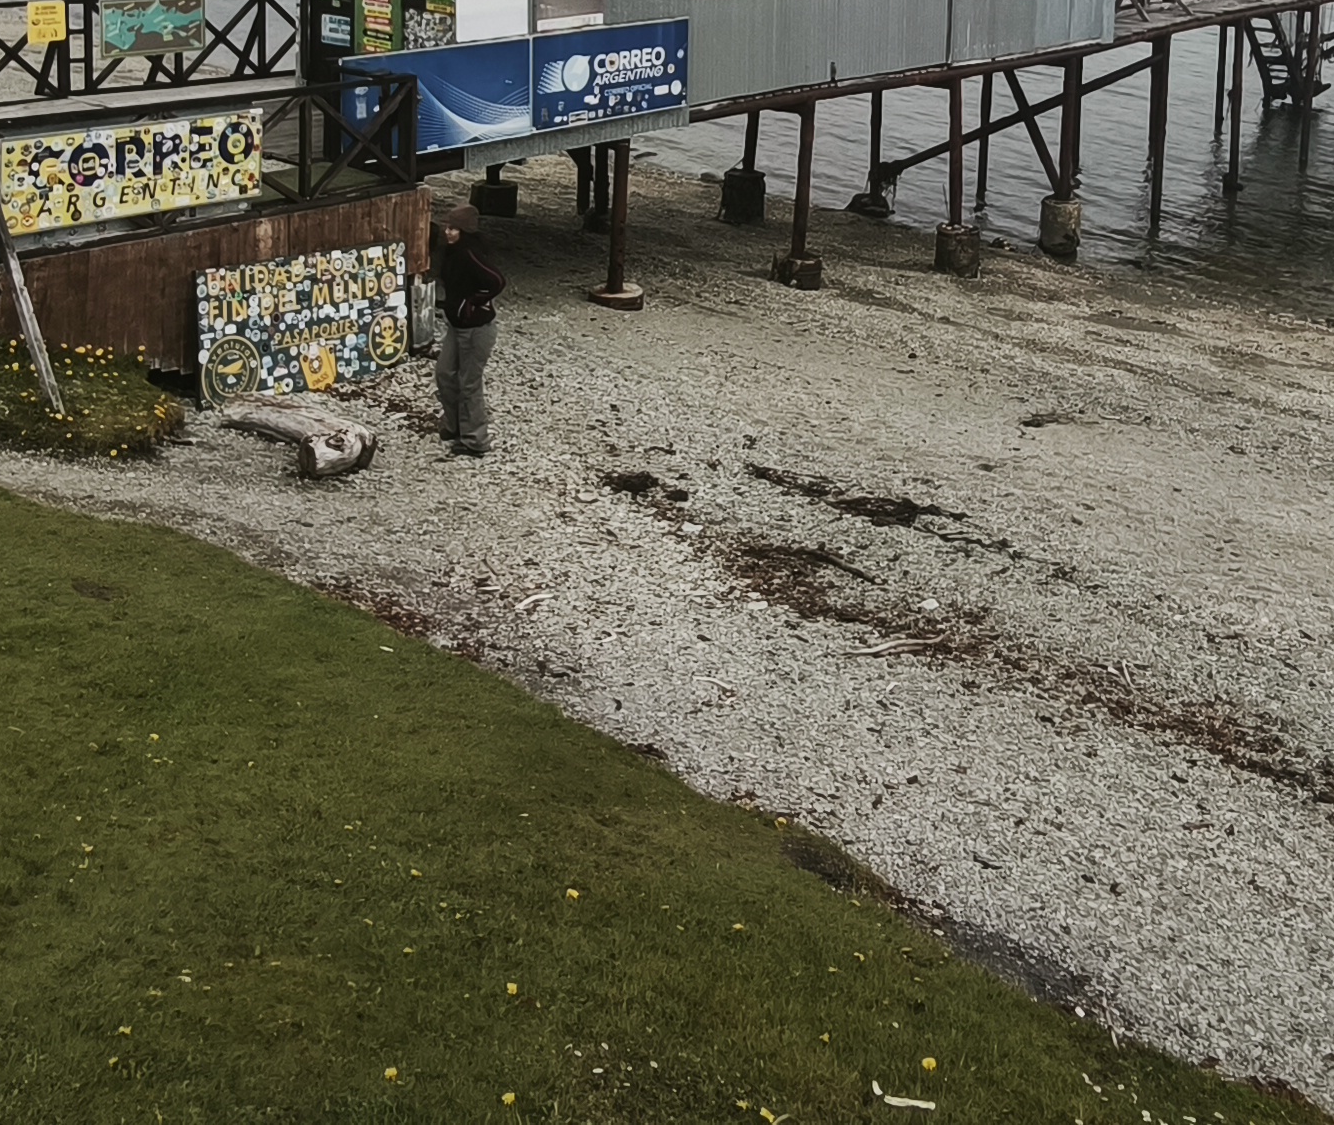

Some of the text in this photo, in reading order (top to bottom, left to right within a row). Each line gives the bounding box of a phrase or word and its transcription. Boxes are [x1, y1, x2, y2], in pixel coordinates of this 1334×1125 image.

[593, 46, 665, 74] CORREO
[593, 65, 664, 86] ARGENTINO
[28, 122, 255, 191] CORREO
[208, 260, 305, 296] UNIDAD
[209, 272, 397, 325] FIN DEL MUNDO
[274, 318, 359, 345] PASAPORTES
